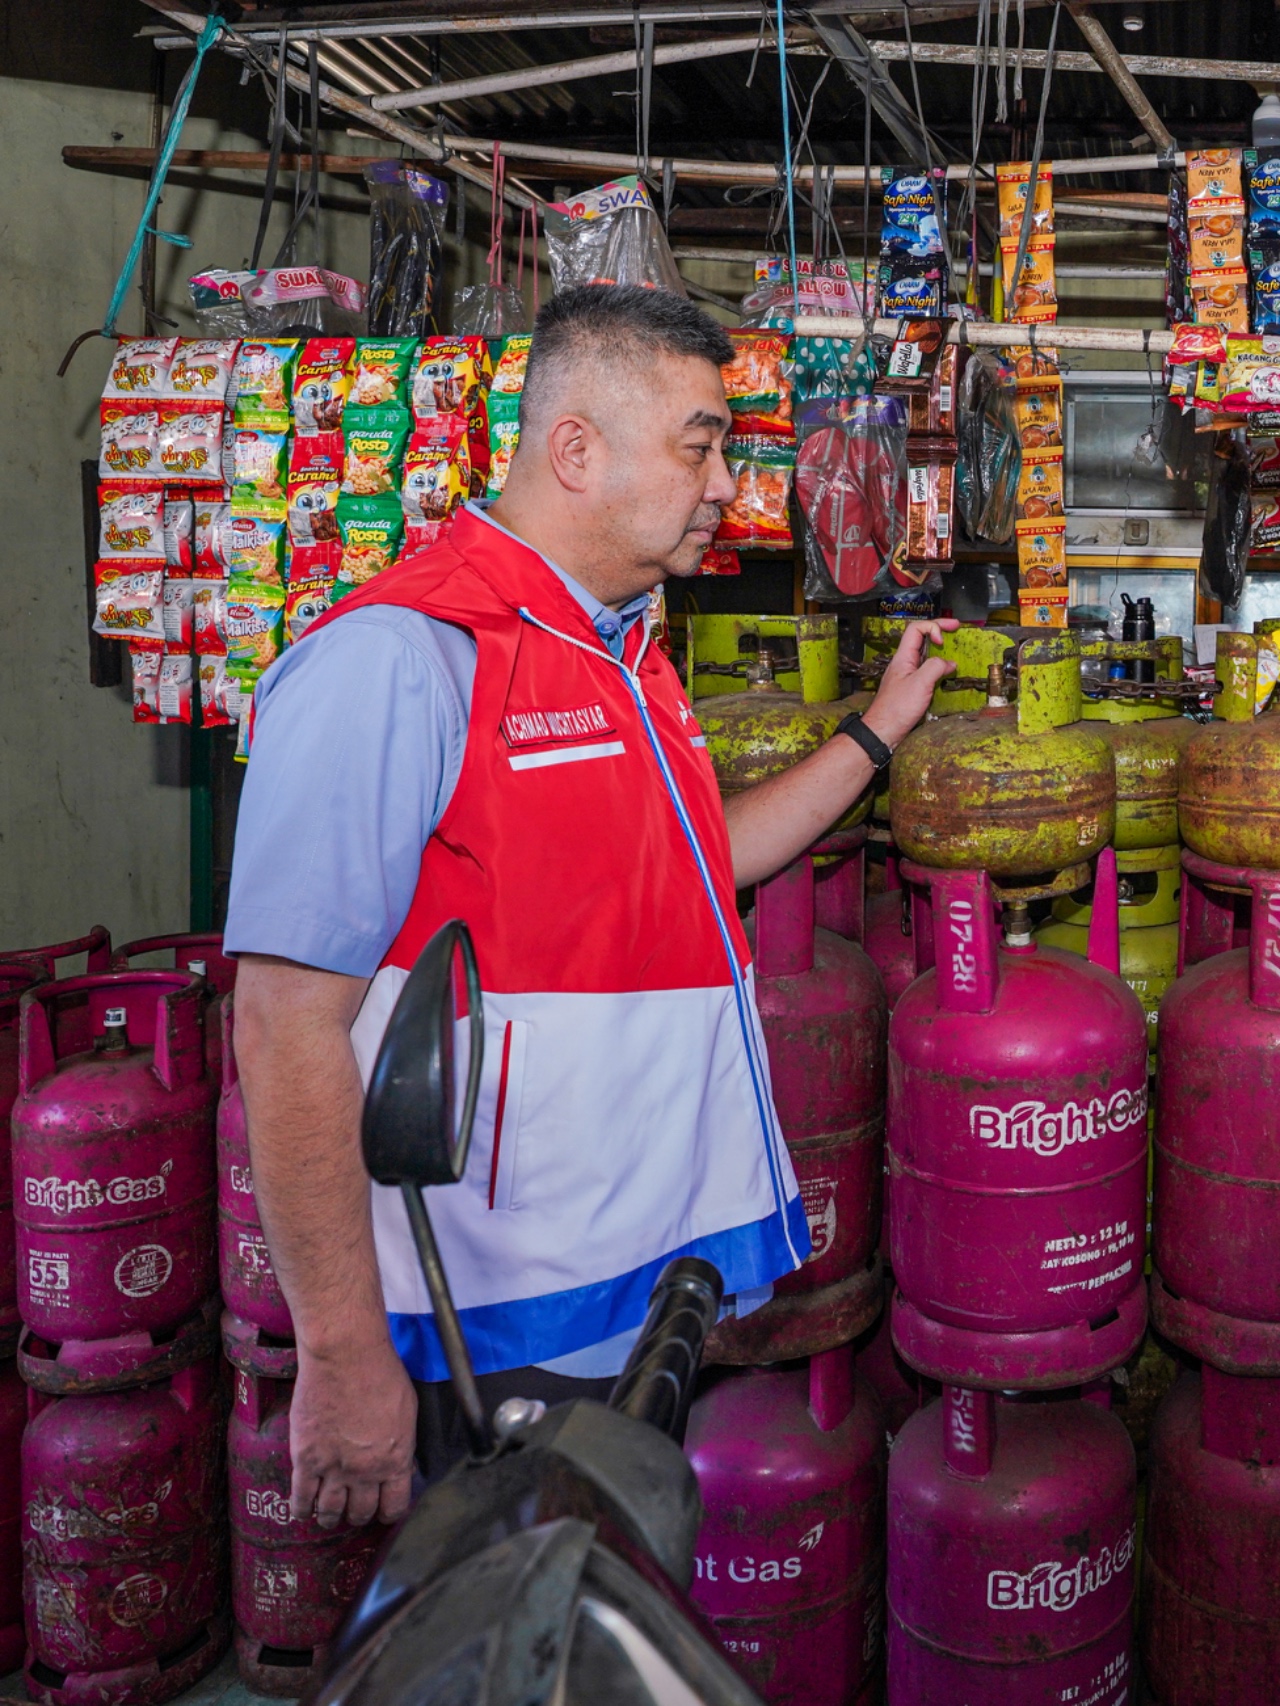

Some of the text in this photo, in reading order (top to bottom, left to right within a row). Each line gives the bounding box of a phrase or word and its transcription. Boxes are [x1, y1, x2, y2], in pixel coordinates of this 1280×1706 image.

[1250, 177, 1275, 188] Safe
[884, 194, 936, 206] Safe Nigh
[1256, 280, 1280, 292] Safe
[907, 295, 937, 308] Night
[360, 350, 396, 360] Rosta
[1237, 353, 1273, 364] KACANG
[348, 429, 393, 440] garuda
[351, 439, 389, 451] Rosta
[914, 468, 924, 502] Wafello
[344, 519, 391, 531] garuda
[348, 528, 388, 542] Rosta
[879, 600, 936, 614] Safe Night
[505, 711, 550, 742] ACHMAD
[948, 900, 978, 994] 07-28
[970, 1101, 1104, 1156] Bright
[25, 1174, 166, 1214] Bright Gas
[1045, 1234, 1088, 1253] NETTO
[1100, 1226, 1113, 1242] 12
[246, 1490, 297, 1526] Brig
[727, 1554, 802, 1585] Gas
[987, 1557, 1112, 1612] Bright
